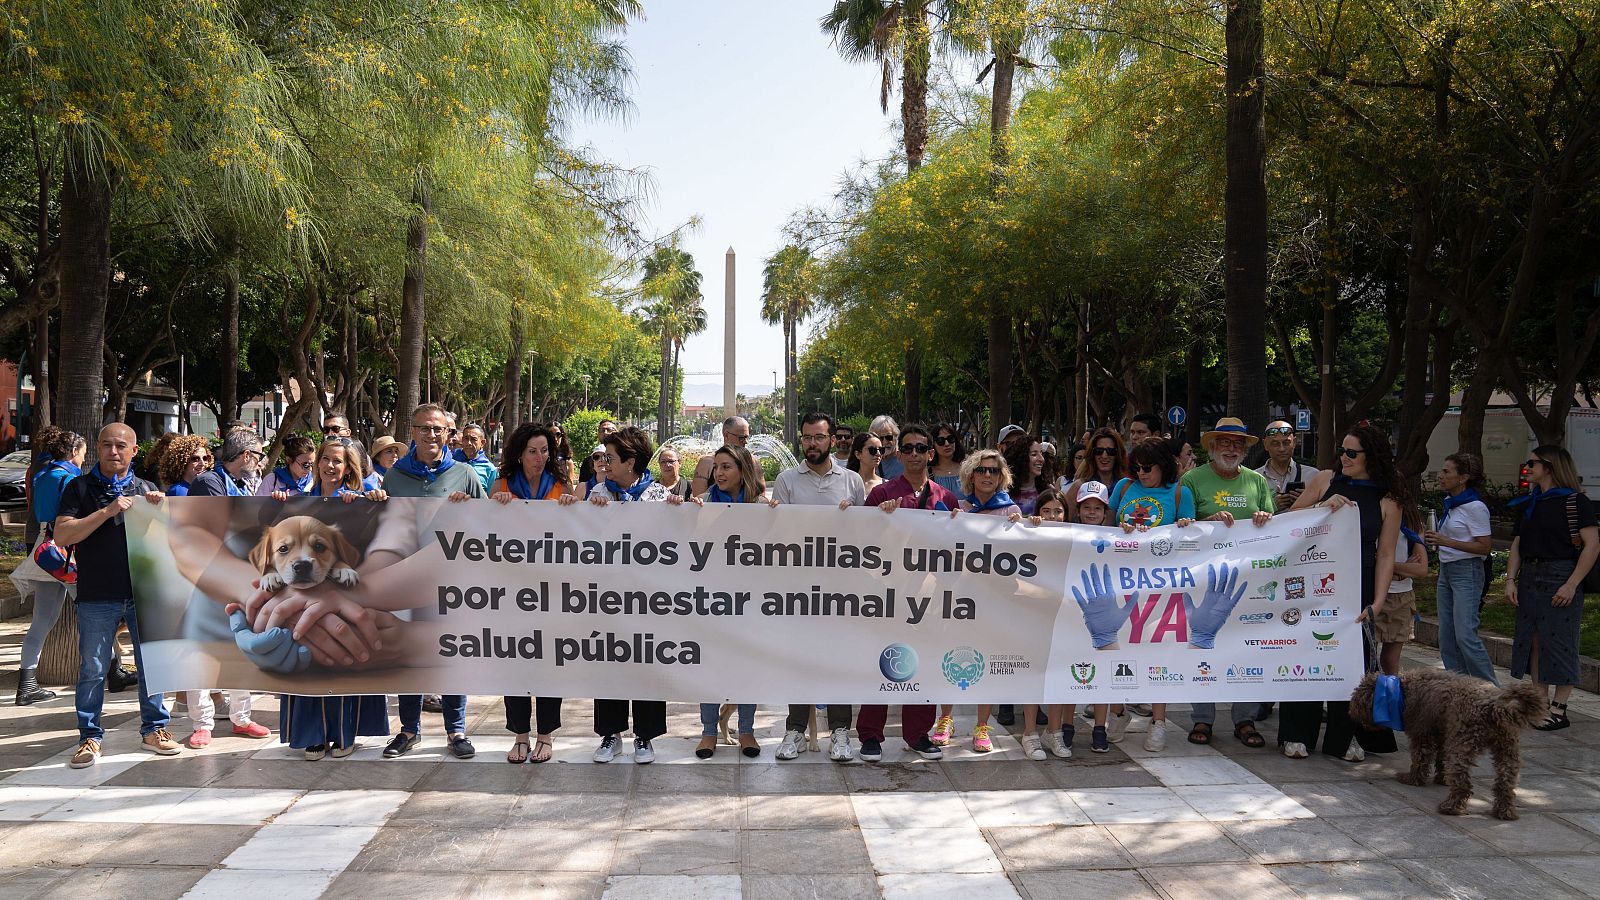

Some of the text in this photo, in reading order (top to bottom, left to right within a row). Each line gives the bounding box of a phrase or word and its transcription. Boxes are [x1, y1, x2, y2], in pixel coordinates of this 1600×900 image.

[435, 531, 1038, 577] Veterinarios y familias, unidos
[1114, 540, 1139, 549] ceve
[1213, 541, 1233, 550] CDVE
[1119, 566, 1196, 589] BASTA
[438, 582, 976, 625] por el bienestar animal y la
[1124, 593, 1188, 643] YA
[438, 628, 701, 666] salud pública
[879, 683, 920, 692] ASAVAC
